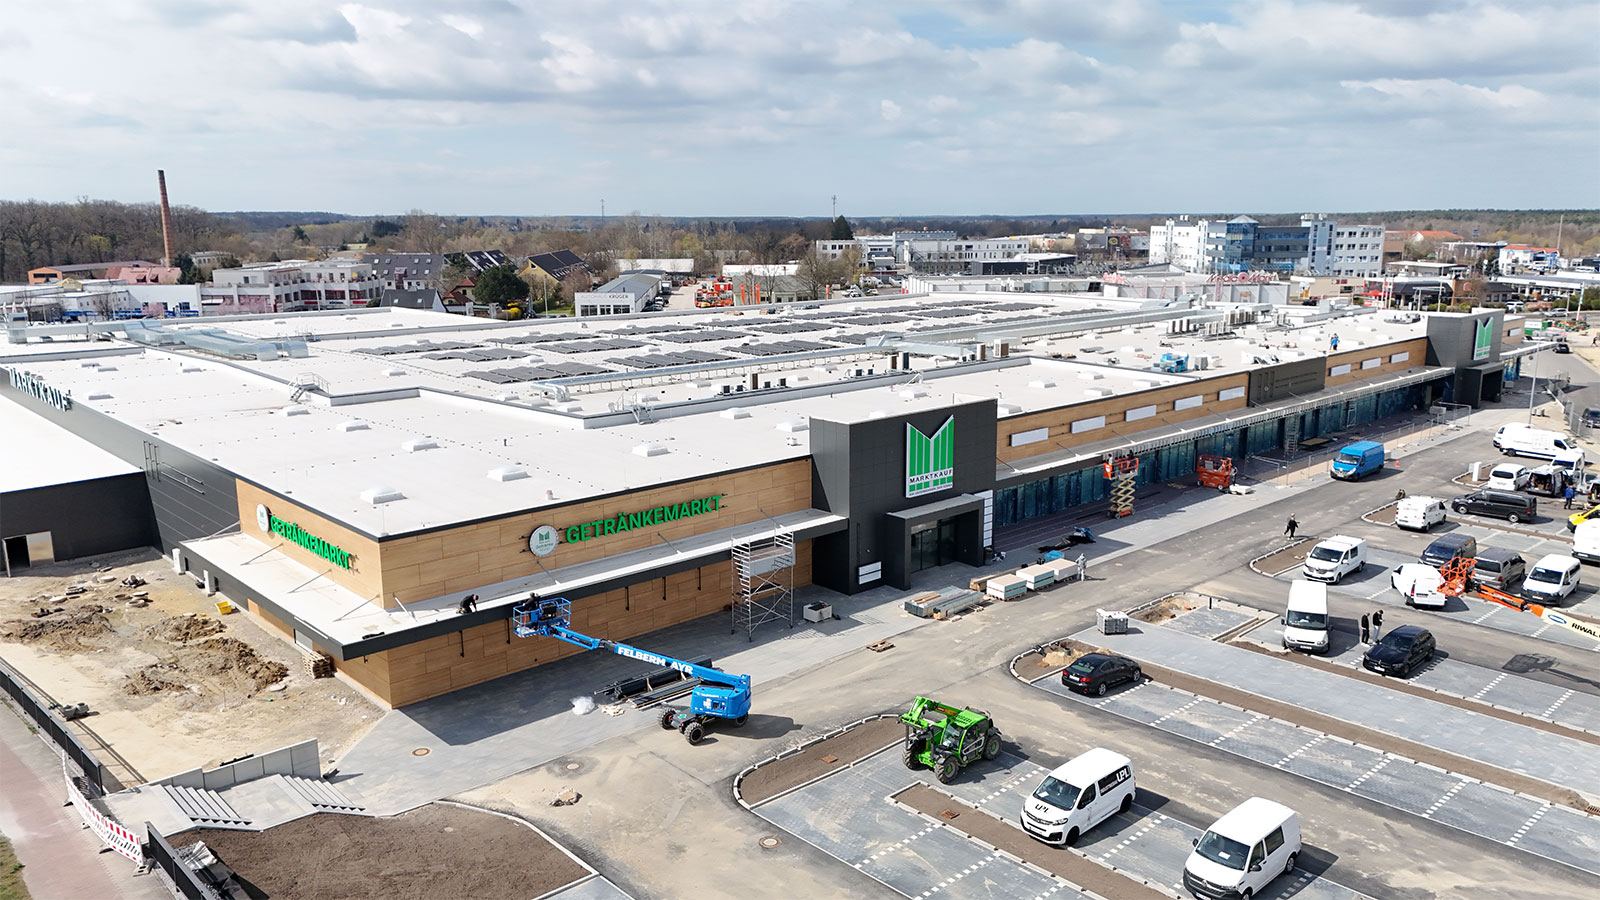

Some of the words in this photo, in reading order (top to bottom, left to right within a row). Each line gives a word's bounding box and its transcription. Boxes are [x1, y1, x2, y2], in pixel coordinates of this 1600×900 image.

[9, 368, 70, 412] MARKTKAUF
[909, 469, 953, 484] MARKTKAUF
[270, 515, 351, 570] GETRÄNKEMARKT
[566, 495, 722, 544] GETRÄNKEMARKT
